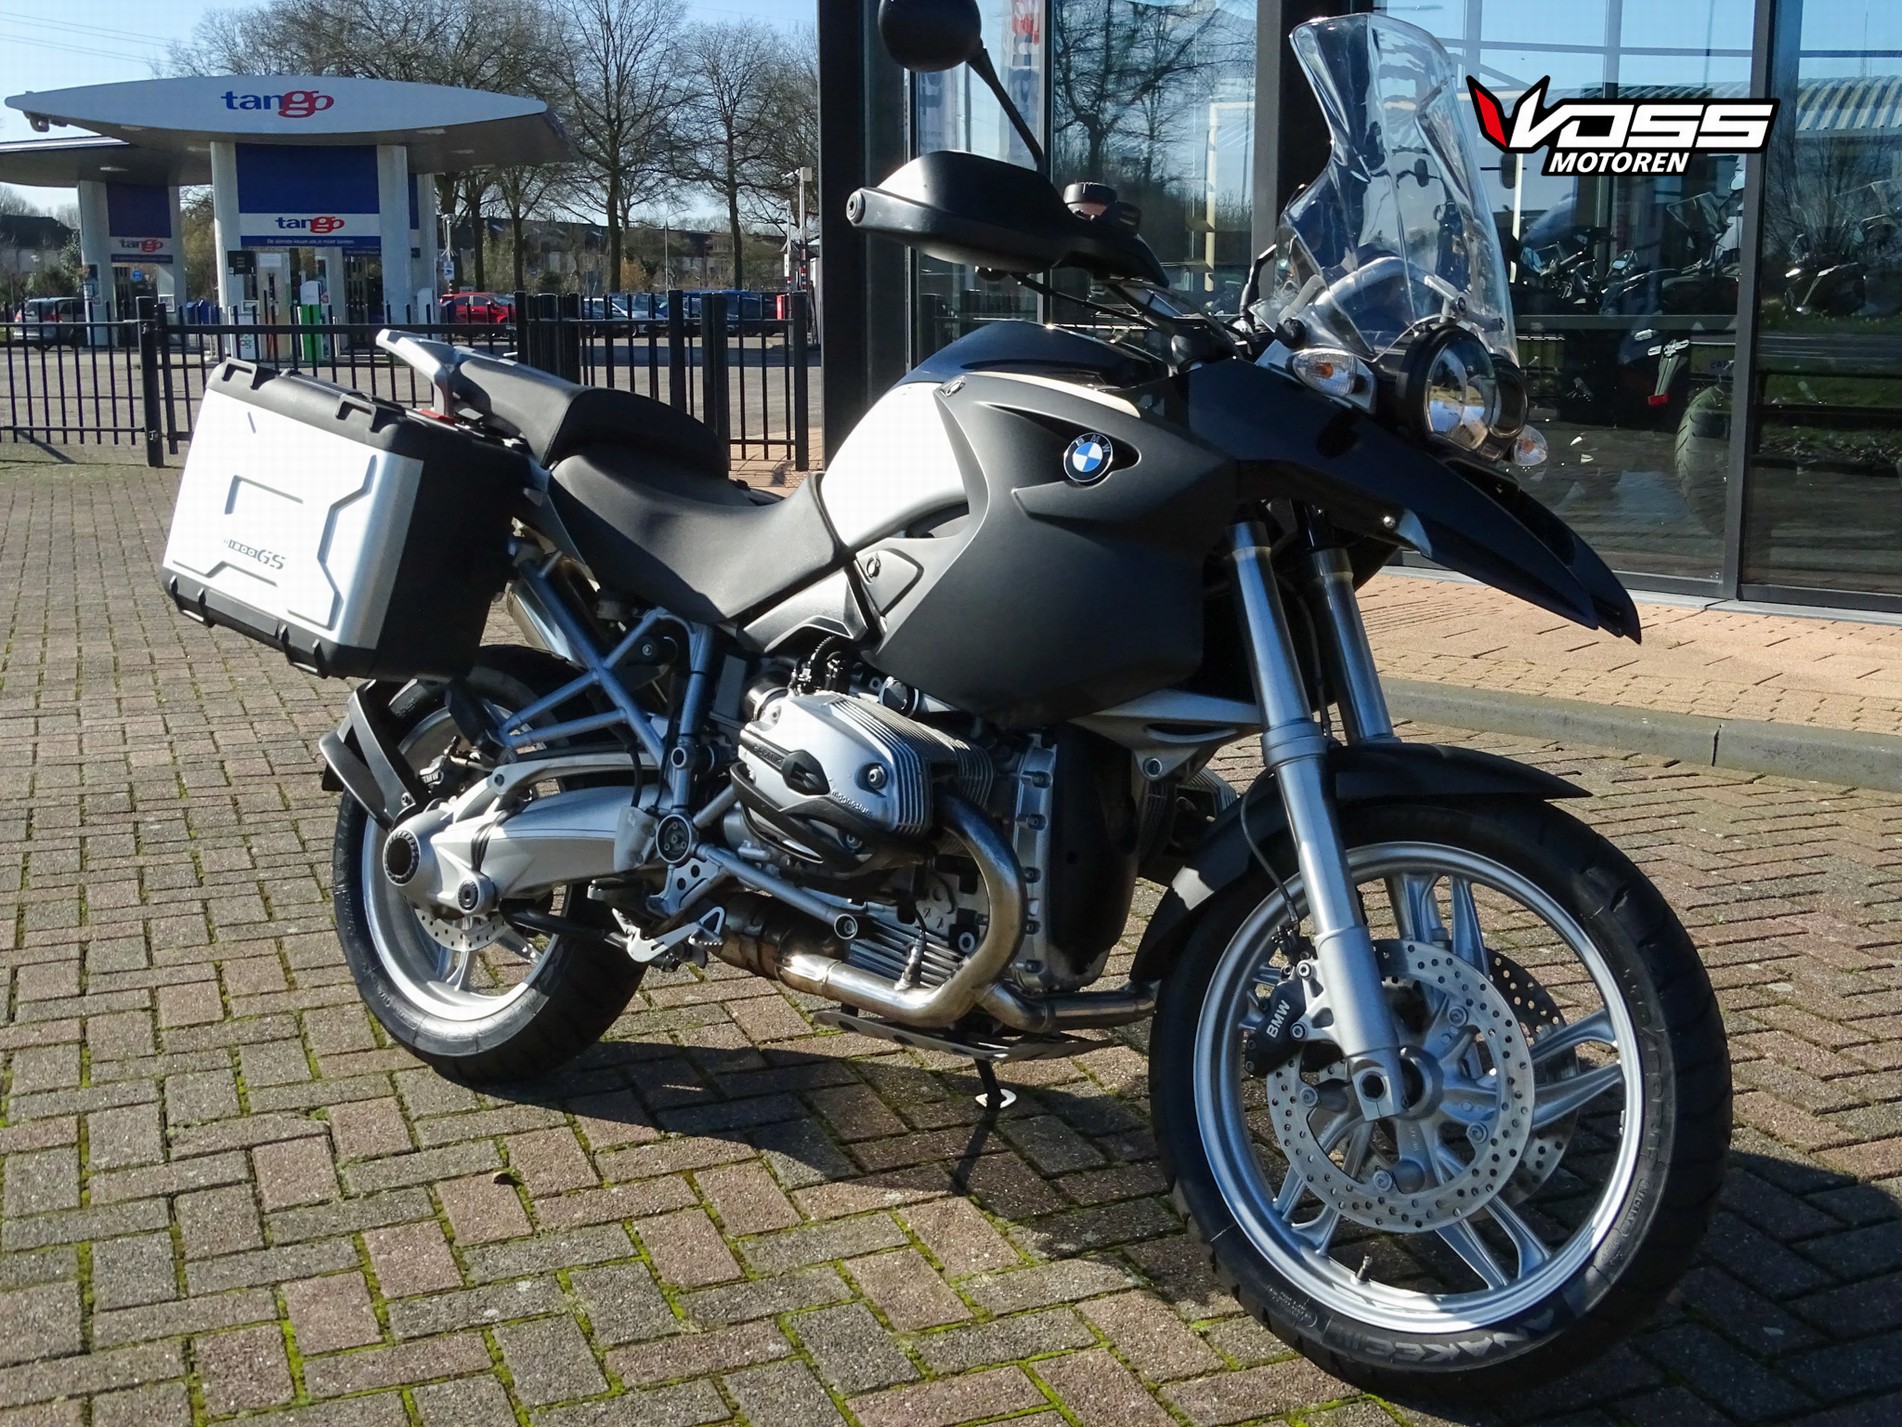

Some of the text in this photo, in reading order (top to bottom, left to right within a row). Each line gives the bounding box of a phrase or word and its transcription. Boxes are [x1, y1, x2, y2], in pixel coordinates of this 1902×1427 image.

[221, 90, 334, 118] tango
[274, 216, 345, 234] tango
[119, 239, 163, 252] tango
[1075, 434, 1111, 453] BMW
[1266, 999, 1290, 1039] BMW
[1366, 1308, 1554, 1362] ANAKEE
